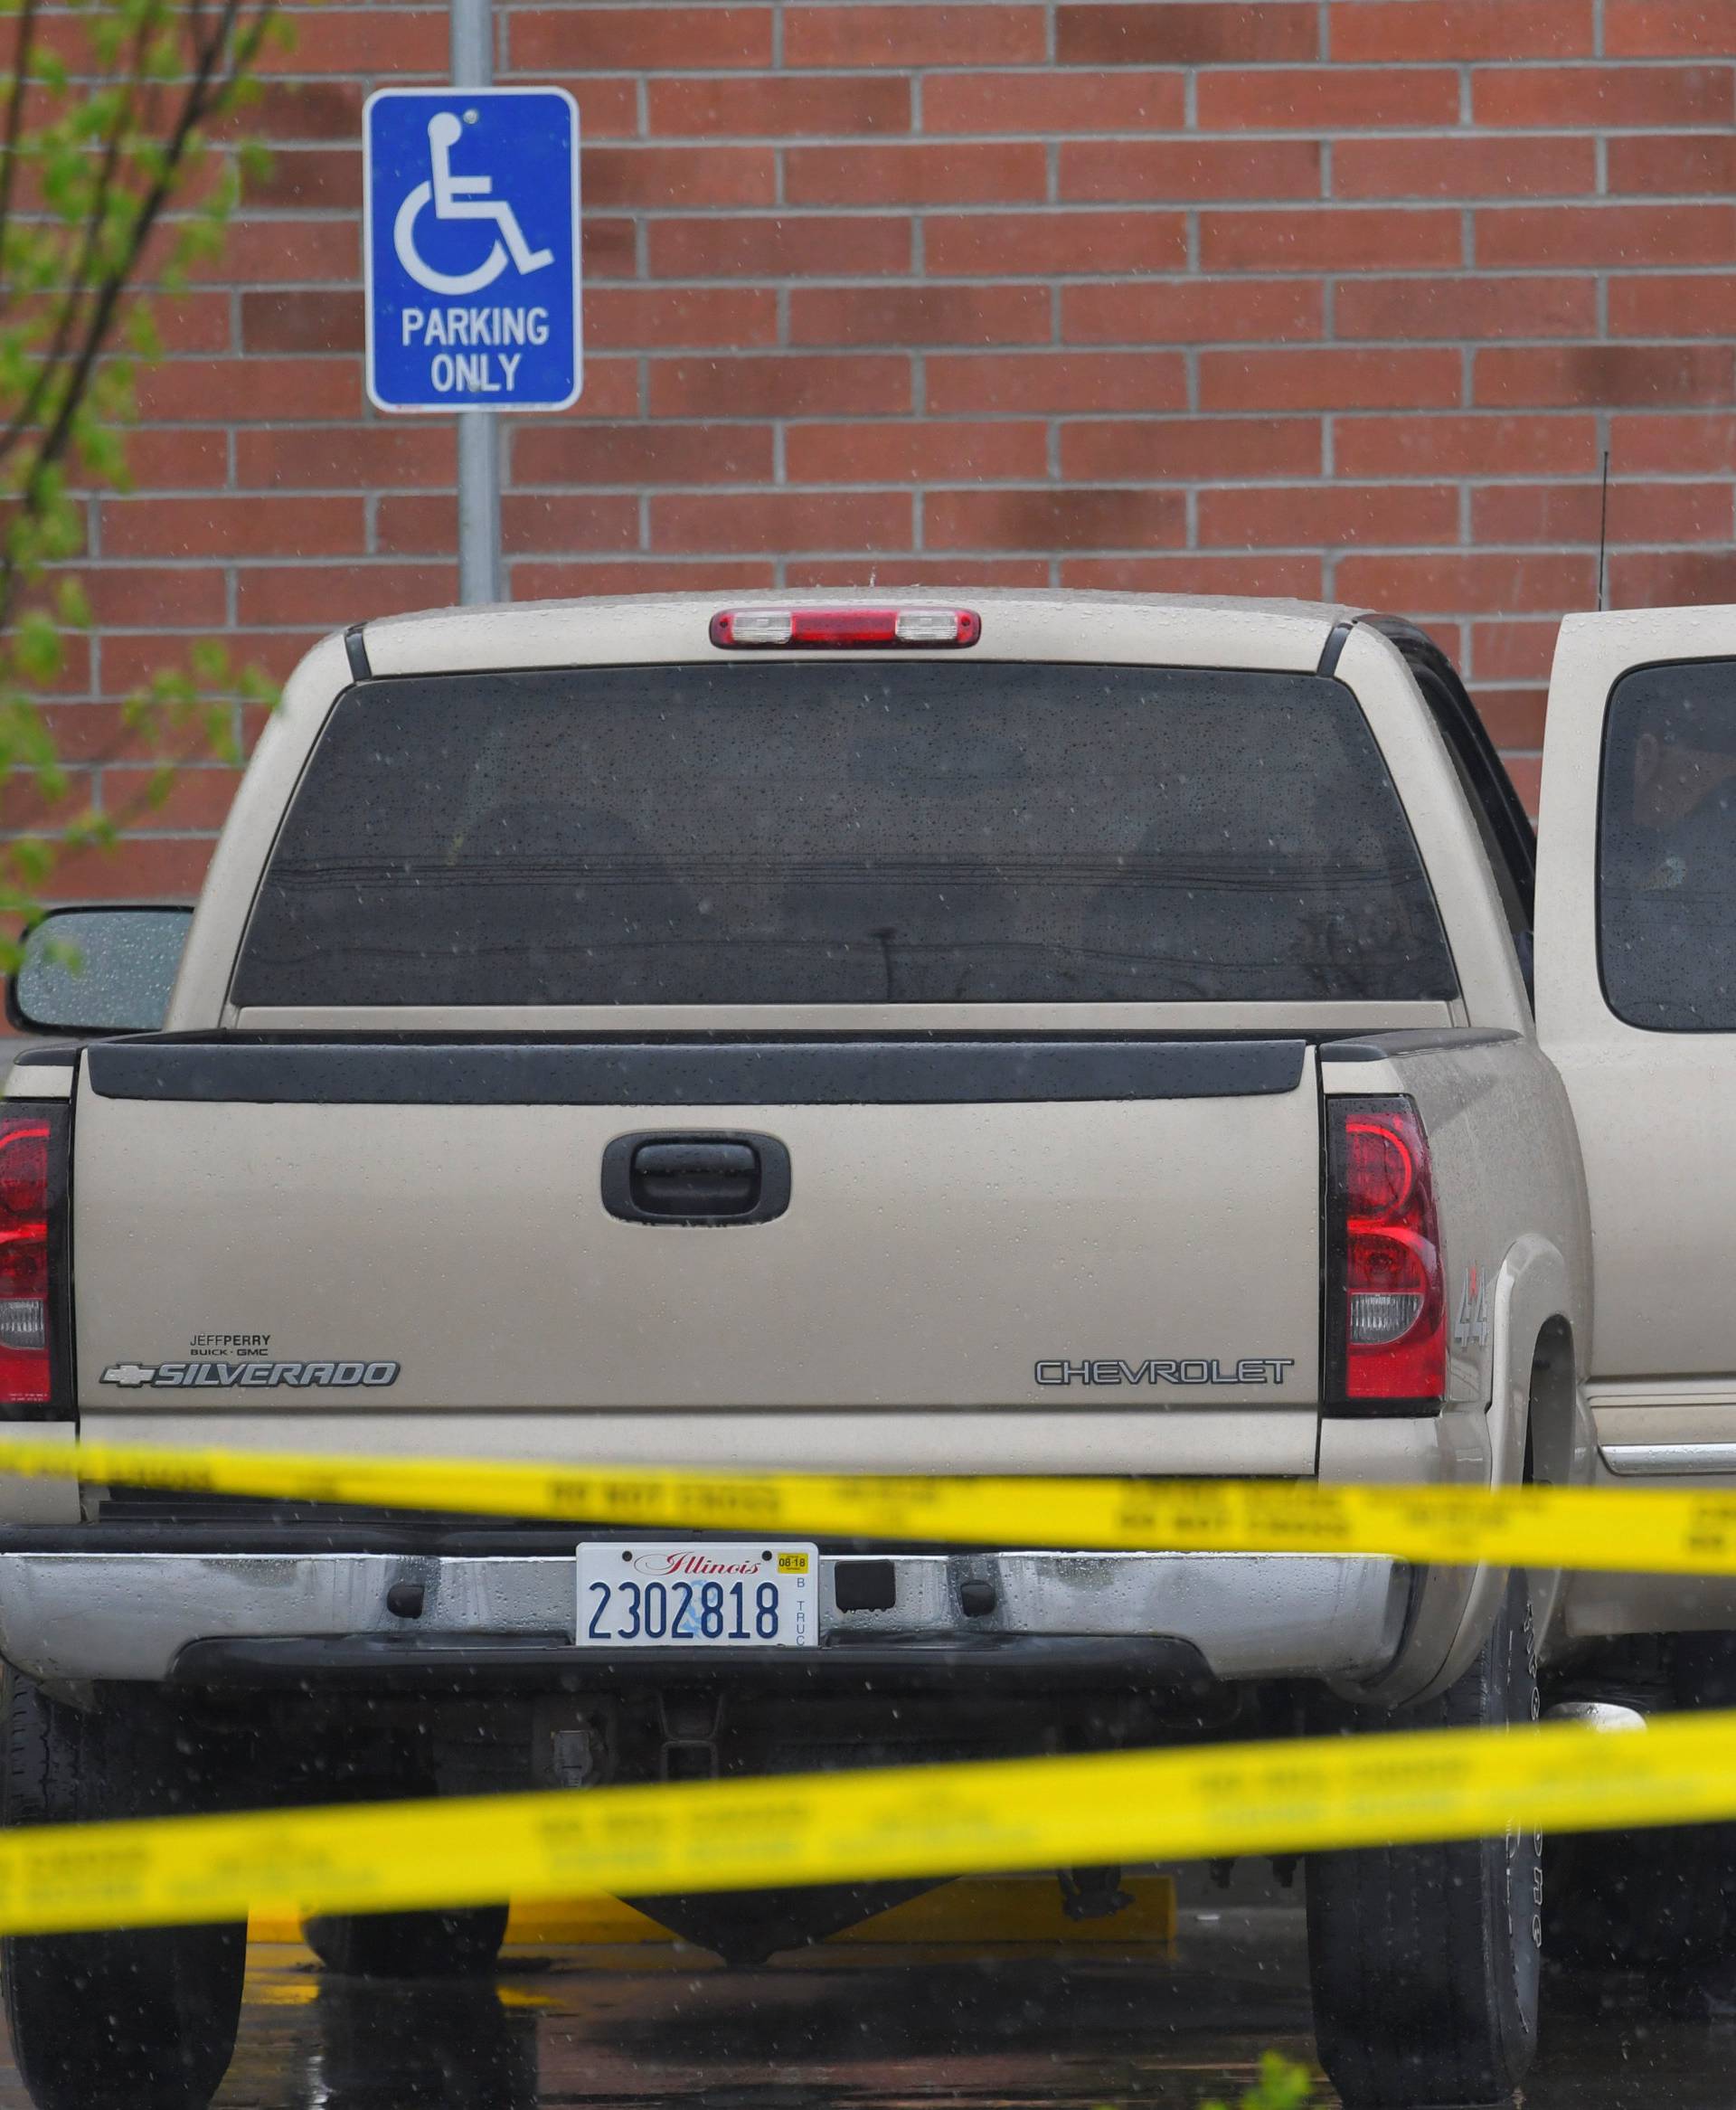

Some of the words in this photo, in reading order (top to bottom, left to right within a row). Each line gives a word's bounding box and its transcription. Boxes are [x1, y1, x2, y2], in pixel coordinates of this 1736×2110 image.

[401, 307, 550, 346] PARKING
[430, 353, 521, 393] ONLY
[190, 1348, 228, 1357] BUICK
[236, 1348, 269, 1357] GMC
[152, 1362, 400, 1386] SILVERADO
[1034, 1358, 1294, 1385] CHEVROLET
[634, 1550, 761, 1575] Illinois
[797, 1577, 805, 1588] B
[589, 1581, 778, 1640] 2302818
